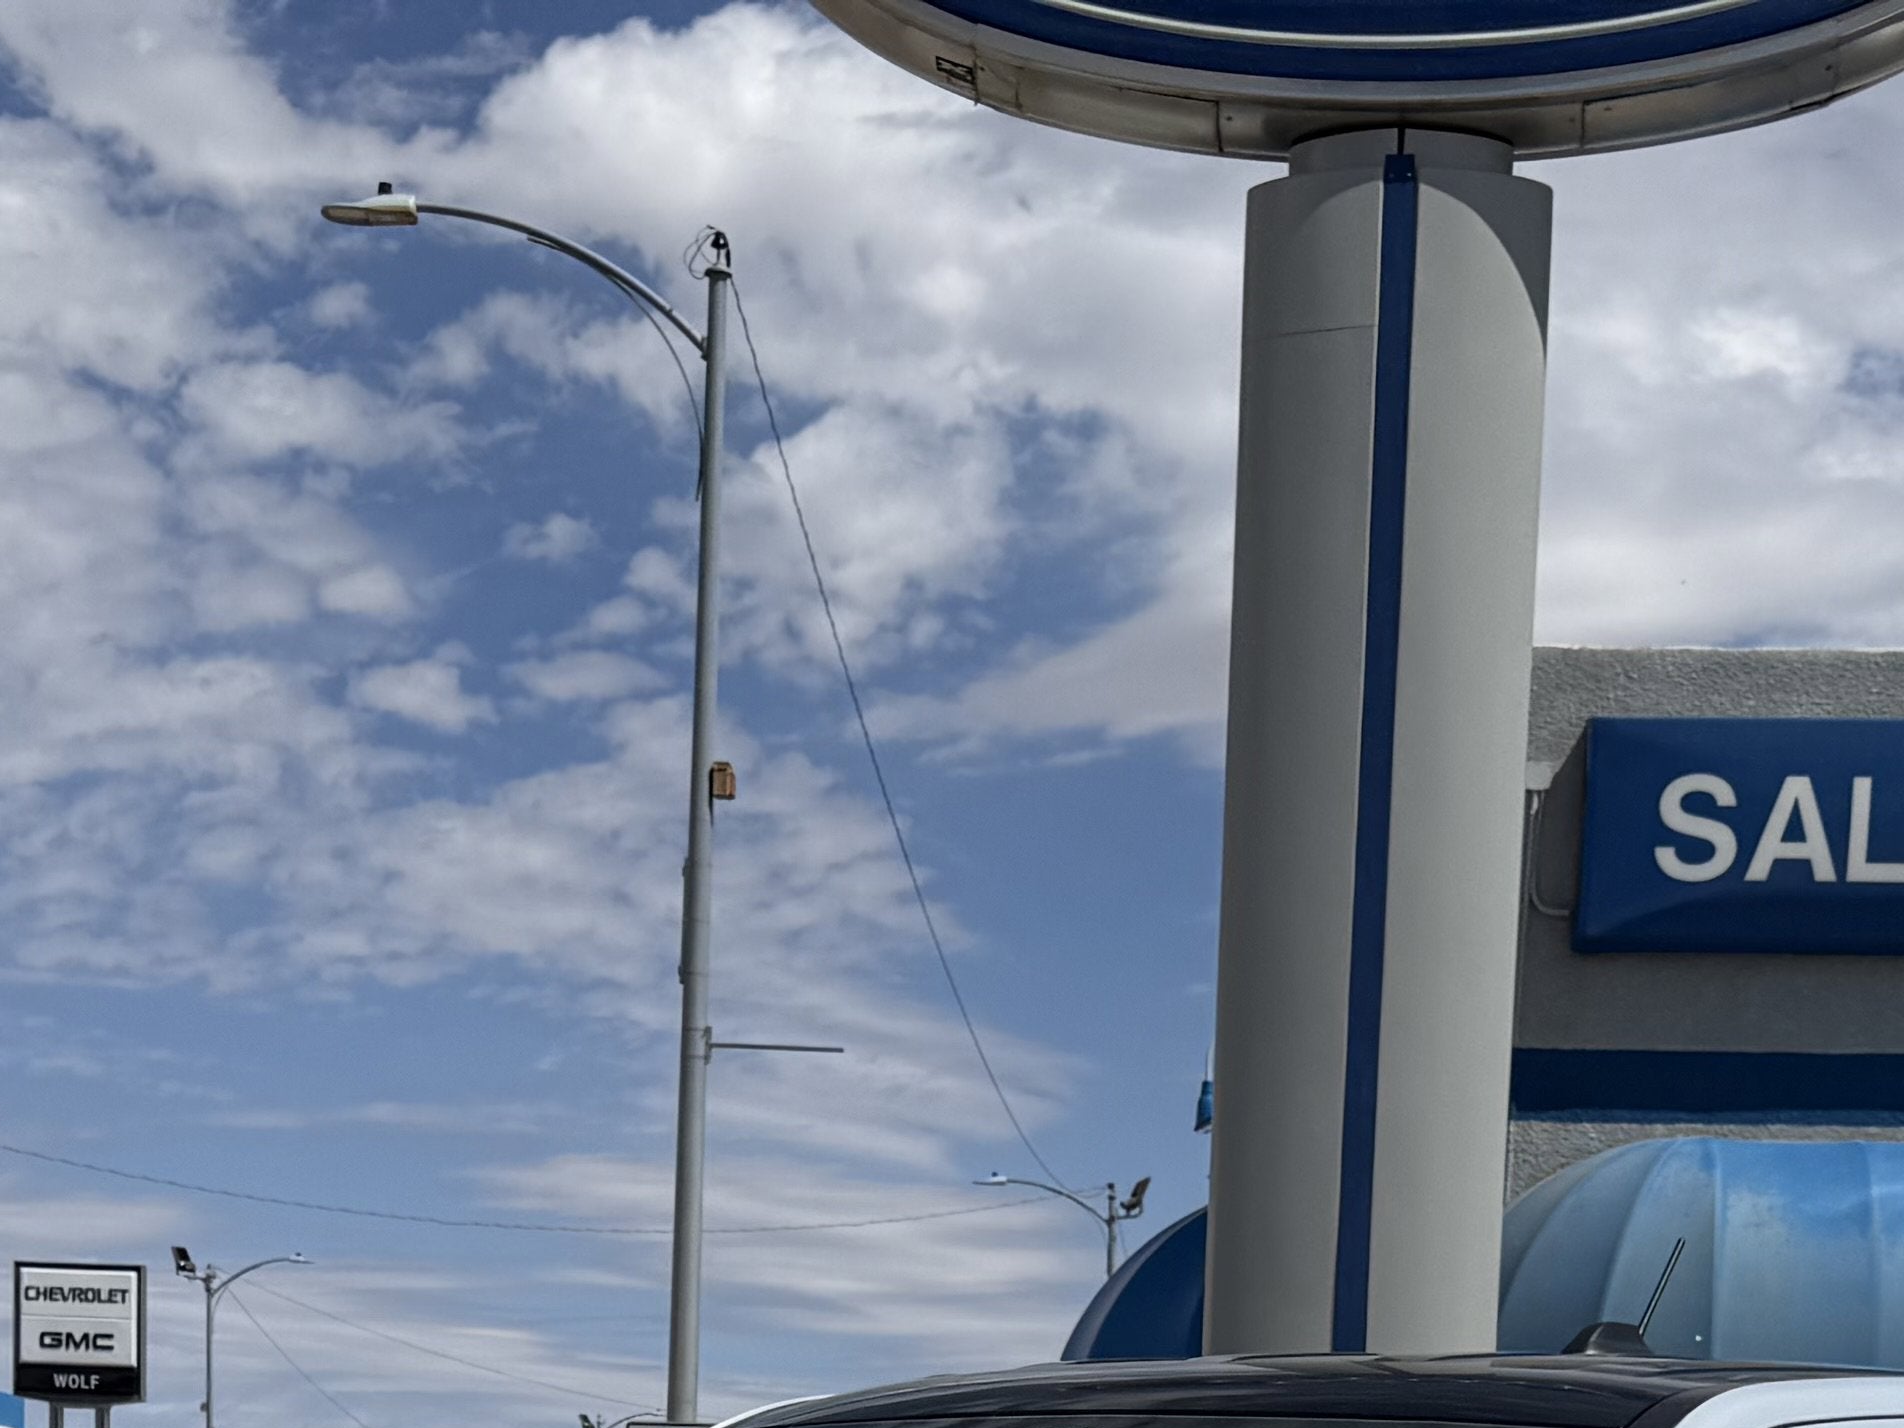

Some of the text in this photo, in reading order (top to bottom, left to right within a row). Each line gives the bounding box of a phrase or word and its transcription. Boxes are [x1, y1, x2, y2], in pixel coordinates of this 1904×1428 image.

[24, 1285, 129, 1304] CHEVROLET
[39, 1331, 115, 1352] GMC
[53, 1373, 100, 1390] WOLF
